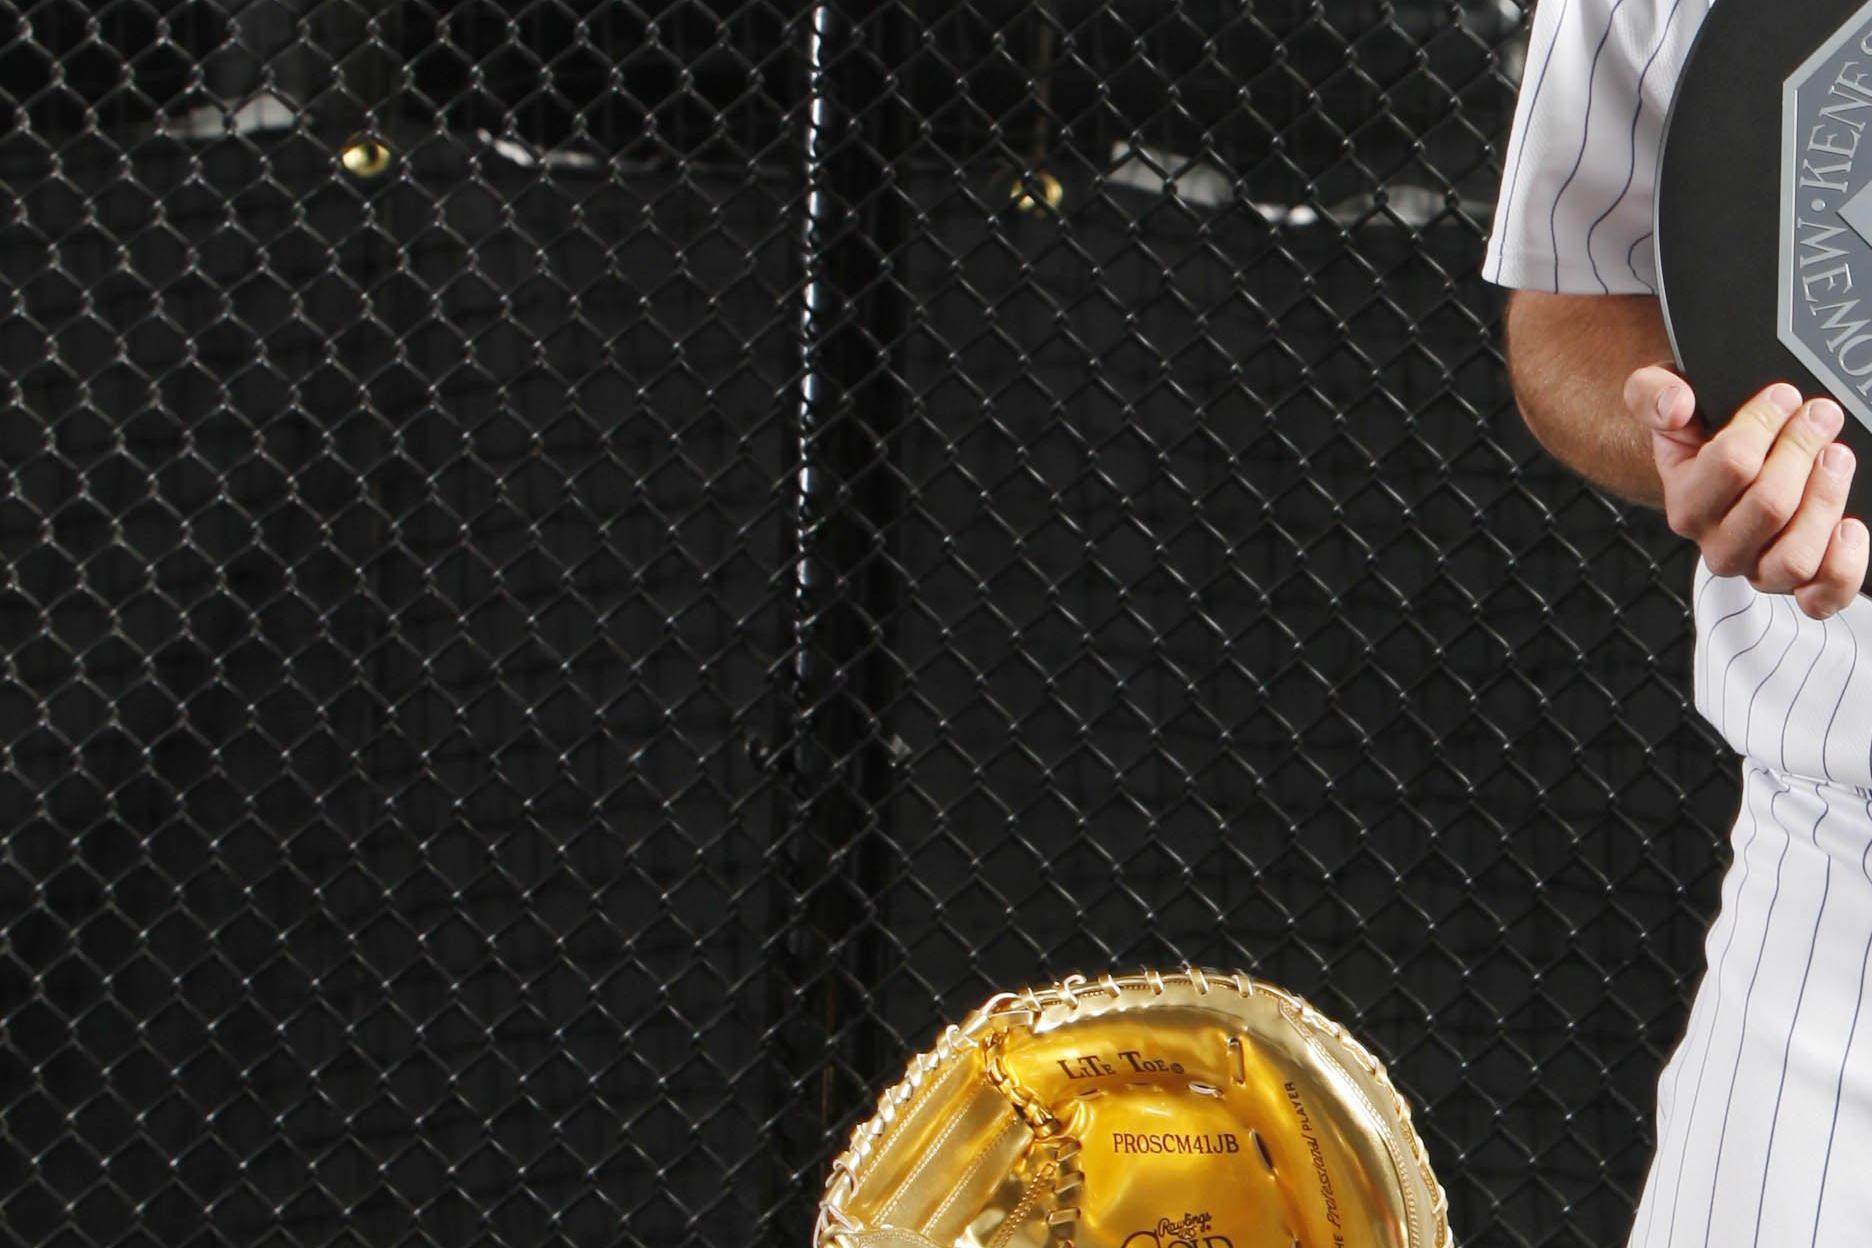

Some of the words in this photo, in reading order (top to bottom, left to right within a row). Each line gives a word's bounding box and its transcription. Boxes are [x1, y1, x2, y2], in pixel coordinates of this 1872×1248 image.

[1283, 1081, 1313, 1132] PLAYER
[1112, 1132, 1241, 1155] PROSCM41JB
[1302, 1133, 1342, 1230] Professional
